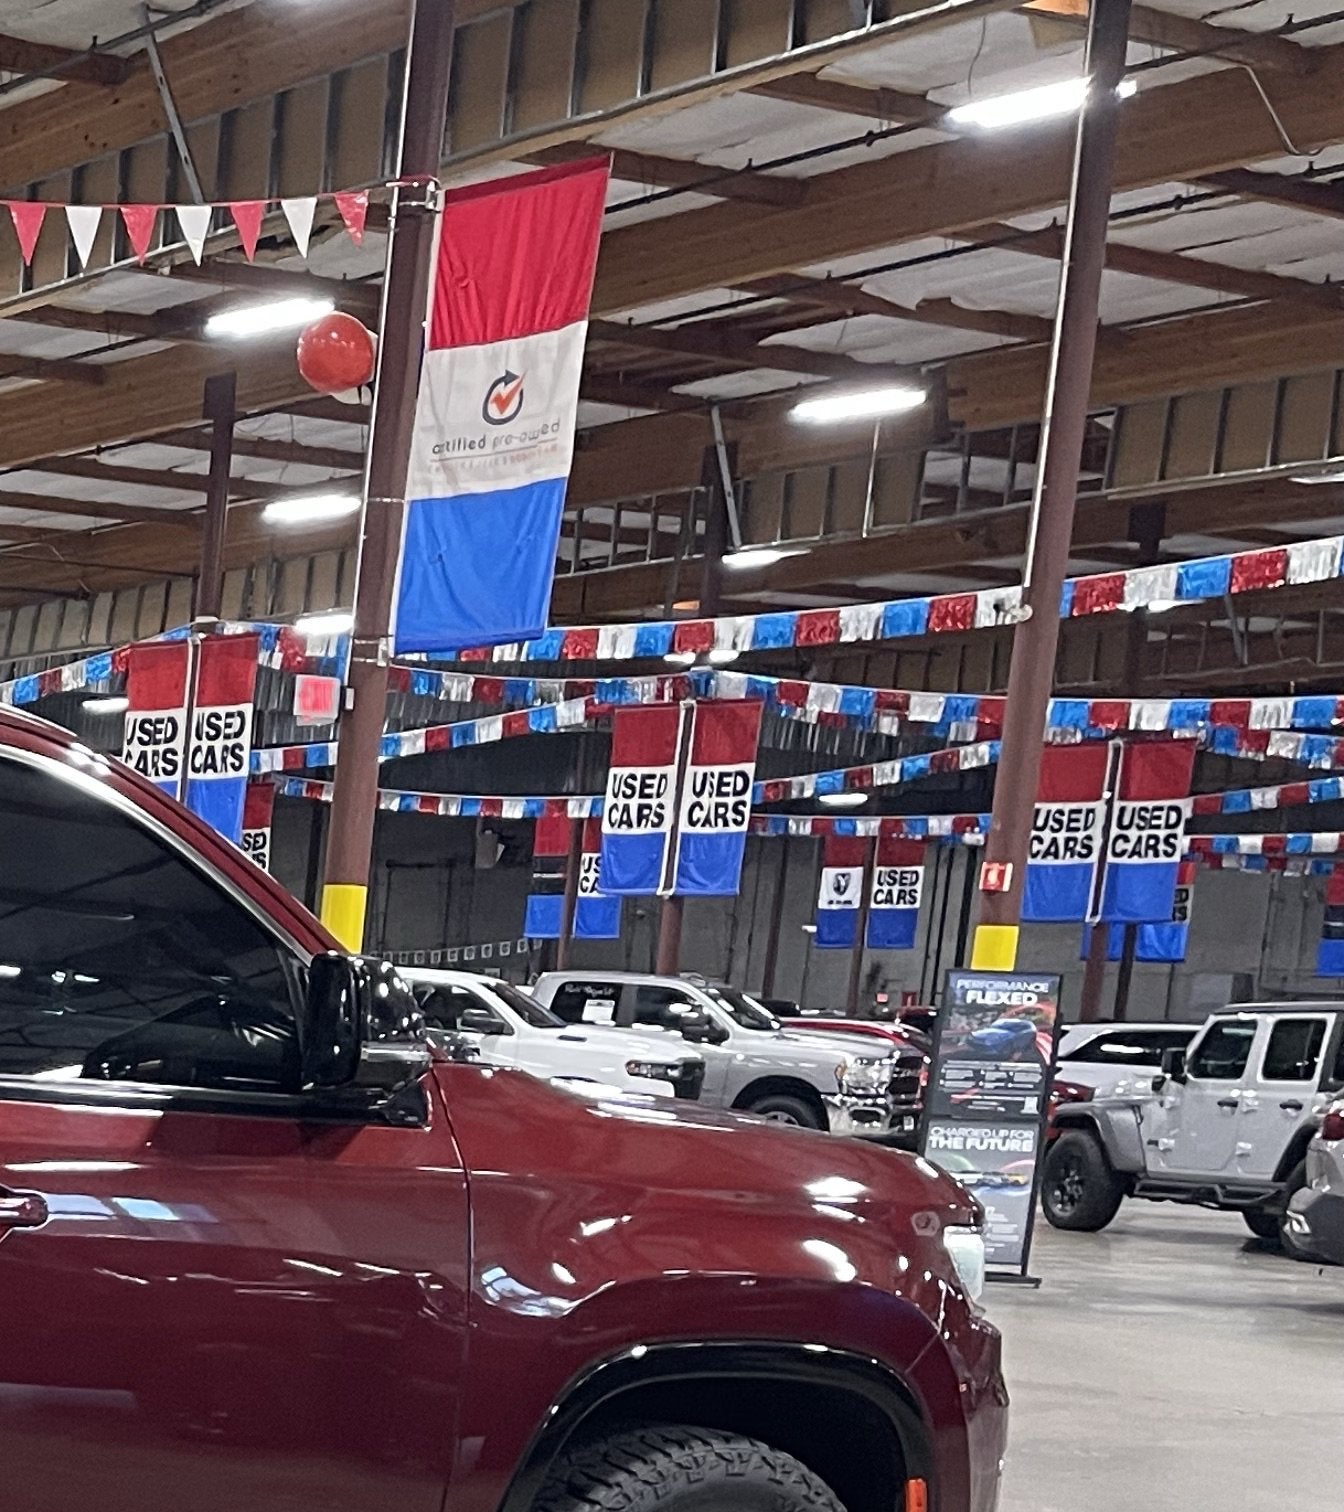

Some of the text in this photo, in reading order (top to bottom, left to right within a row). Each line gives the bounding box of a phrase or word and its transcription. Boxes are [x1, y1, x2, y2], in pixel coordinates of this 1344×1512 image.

[126, 716, 179, 746] USED
[195, 710, 246, 741] USED
[191, 743, 245, 774] CARS
[612, 773, 668, 800] USED
[692, 769, 750, 798] USED
[608, 802, 665, 829] CARS
[688, 799, 748, 828] CARS
[1033, 808, 1096, 833] USED
[1116, 805, 1183, 830] USED
[243, 832, 267, 851] SED
[1029, 834, 1093, 860] CARS
[1112, 832, 1178, 859] CARS
[877, 869, 919, 887] USED
[873, 889, 918, 905] CARS
[957, 979, 1049, 993] PERFORMANCE
[966, 990, 1038, 1006] FLEXED
[929, 1135, 1034, 1152] THE FUTURE
[992, 1129, 1009, 1138] UP
[1010, 1129, 1034, 1140] FOR
